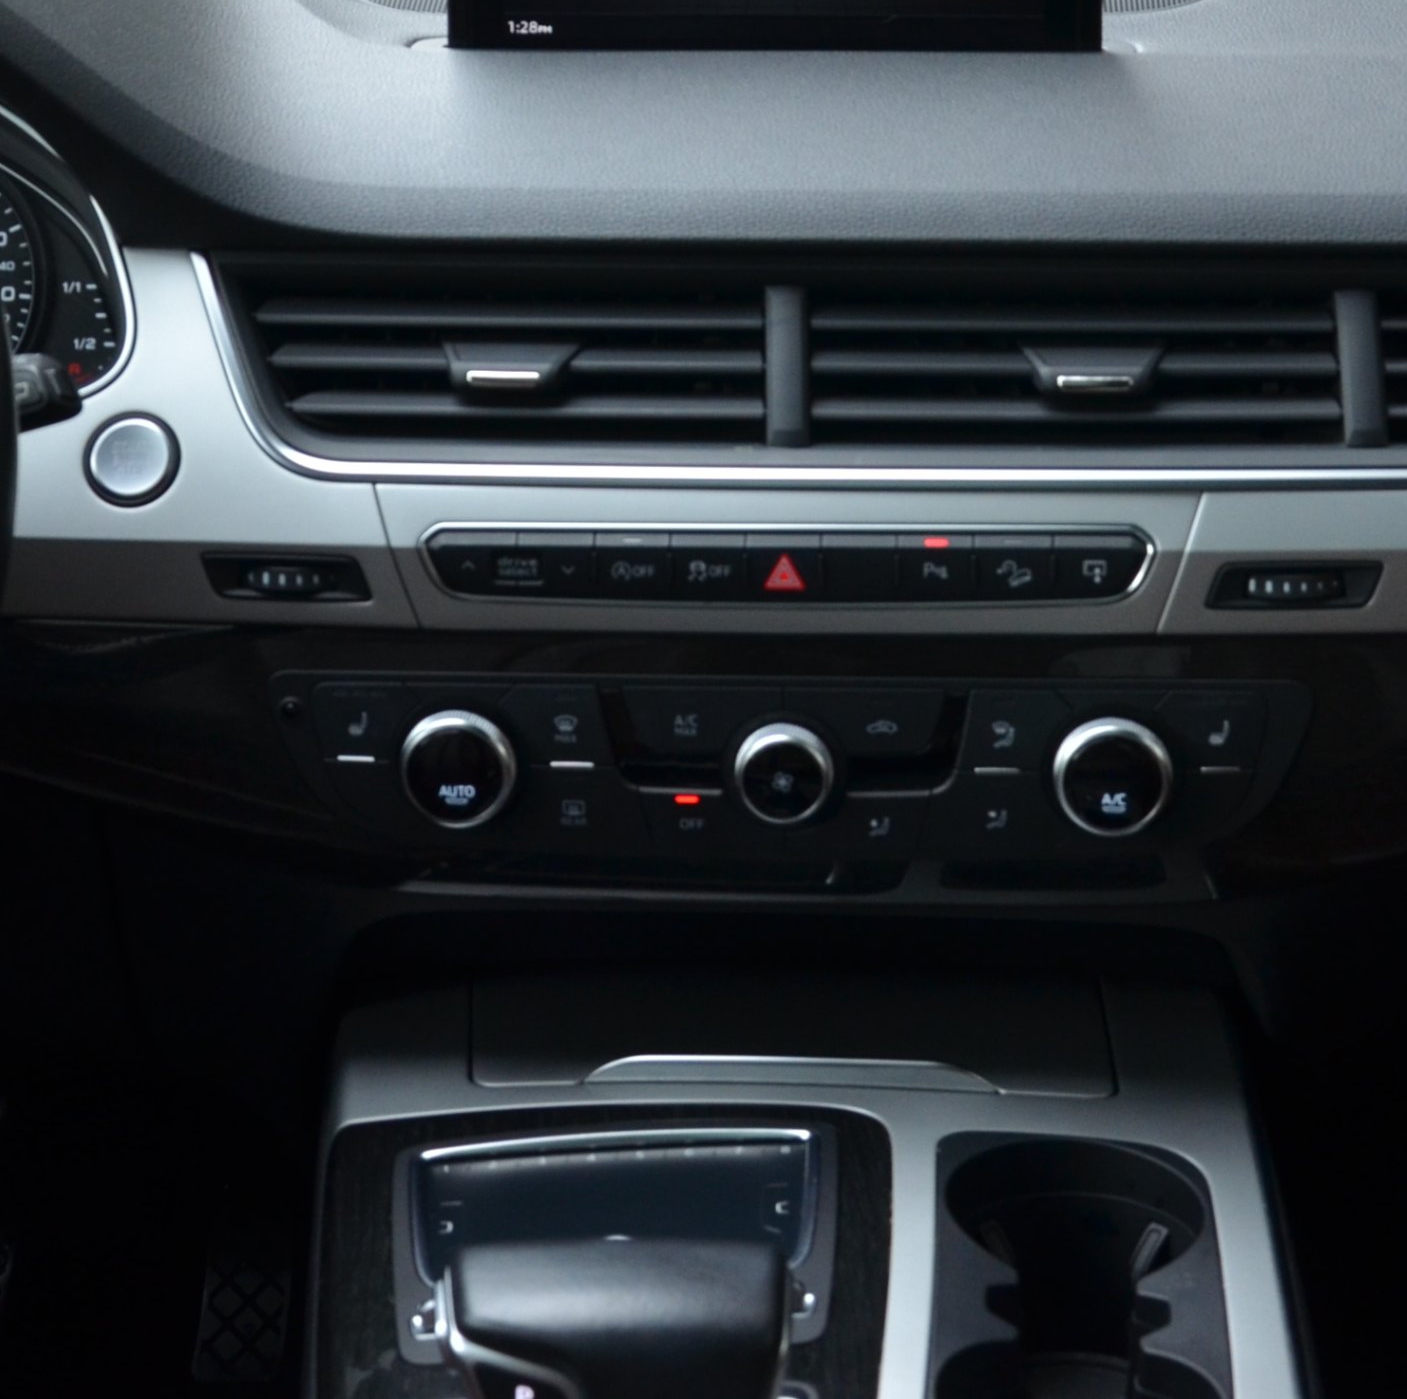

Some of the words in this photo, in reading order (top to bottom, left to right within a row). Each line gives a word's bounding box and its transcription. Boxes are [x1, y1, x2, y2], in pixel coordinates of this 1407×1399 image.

[62, 282, 81, 294] 1/1
[73, 338, 96, 350] 1/2
[497, 555, 538, 568] drive
[497, 566, 538, 578] select
[633, 564, 655, 578] OFF
[709, 565, 732, 578] OFF
[674, 713, 699, 727] A/C
[438, 785, 477, 800] AUTO
[1101, 792, 1127, 806] A/C
[678, 817, 705, 830] OFF
